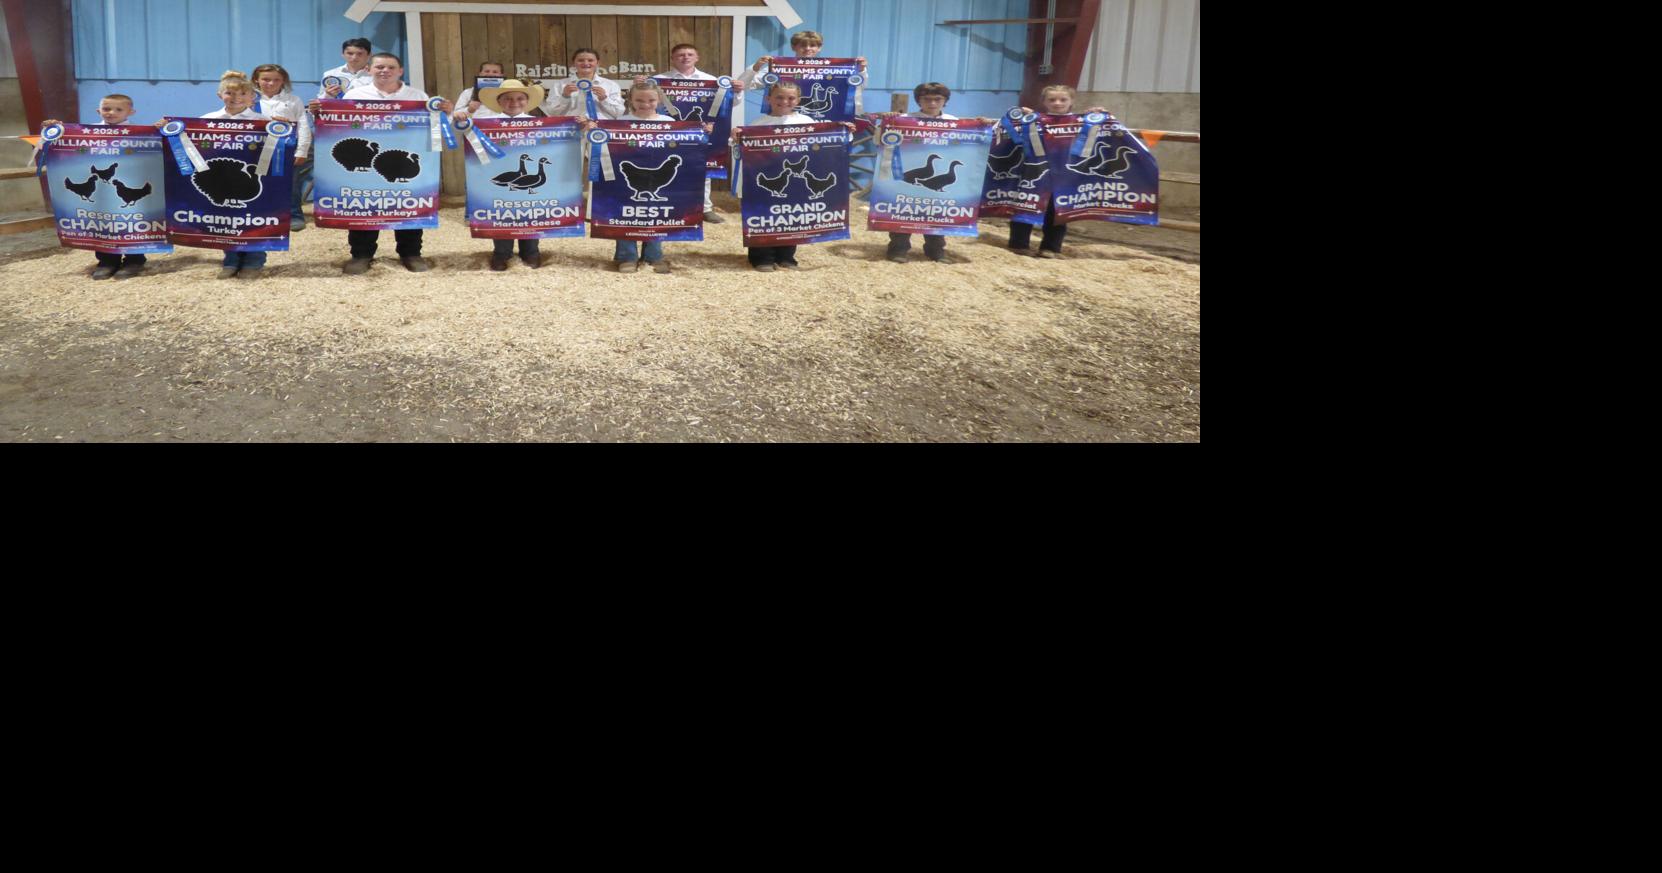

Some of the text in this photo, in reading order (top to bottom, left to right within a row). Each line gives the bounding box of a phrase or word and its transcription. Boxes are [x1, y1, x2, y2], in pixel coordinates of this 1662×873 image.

[618, 61, 656, 73] Barn
[318, 114, 430, 123] WILLIAMS COUNT
[217, 122, 244, 130] 2026
[363, 122, 393, 130] FAIR
[191, 133, 264, 143] LIAMS COU
[489, 130, 576, 140] LIAMS COUNTY
[609, 132, 705, 141] ILLIAMS COUNTY
[941, 132, 987, 141] COUNTY
[111, 140, 163, 148] COUNTY
[213, 142, 244, 150] FAIR
[638, 140, 665, 148] FAIR
[742, 135, 847, 147] WILLIAMS COUNTY
[90, 147, 120, 155] FAIR
[340, 187, 412, 197] Reserve
[1077, 182, 1129, 193] GRAND
[318, 196, 434, 209] CHAMPION
[493, 198, 559, 209] Reserve
[896, 194, 957, 206] Reserve
[1056, 191, 1156, 206] CHAMPION
[770, 202, 827, 215] GRAND
[874, 202, 974, 218] CHAMPION
[1073, 201, 1134, 209] Market Ducks
[76, 208, 144, 221] Reserve
[334, 209, 418, 218] Market Turkeys
[473, 206, 580, 221] CHAMPION
[622, 205, 675, 218] BEST
[173, 210, 279, 229] Champion
[493, 219, 561, 228] Market Geese
[609, 218, 685, 226] Standard Pullet
[746, 210, 846, 227] CHAMPION
[891, 214, 955, 224] Market Ducks
[59, 218, 167, 233] CHAMPION
[207, 225, 243, 236] Turkey
[783, 224, 812, 232] Market
[813, 222, 845, 230] Chickens
[95, 232, 121, 240] Market
